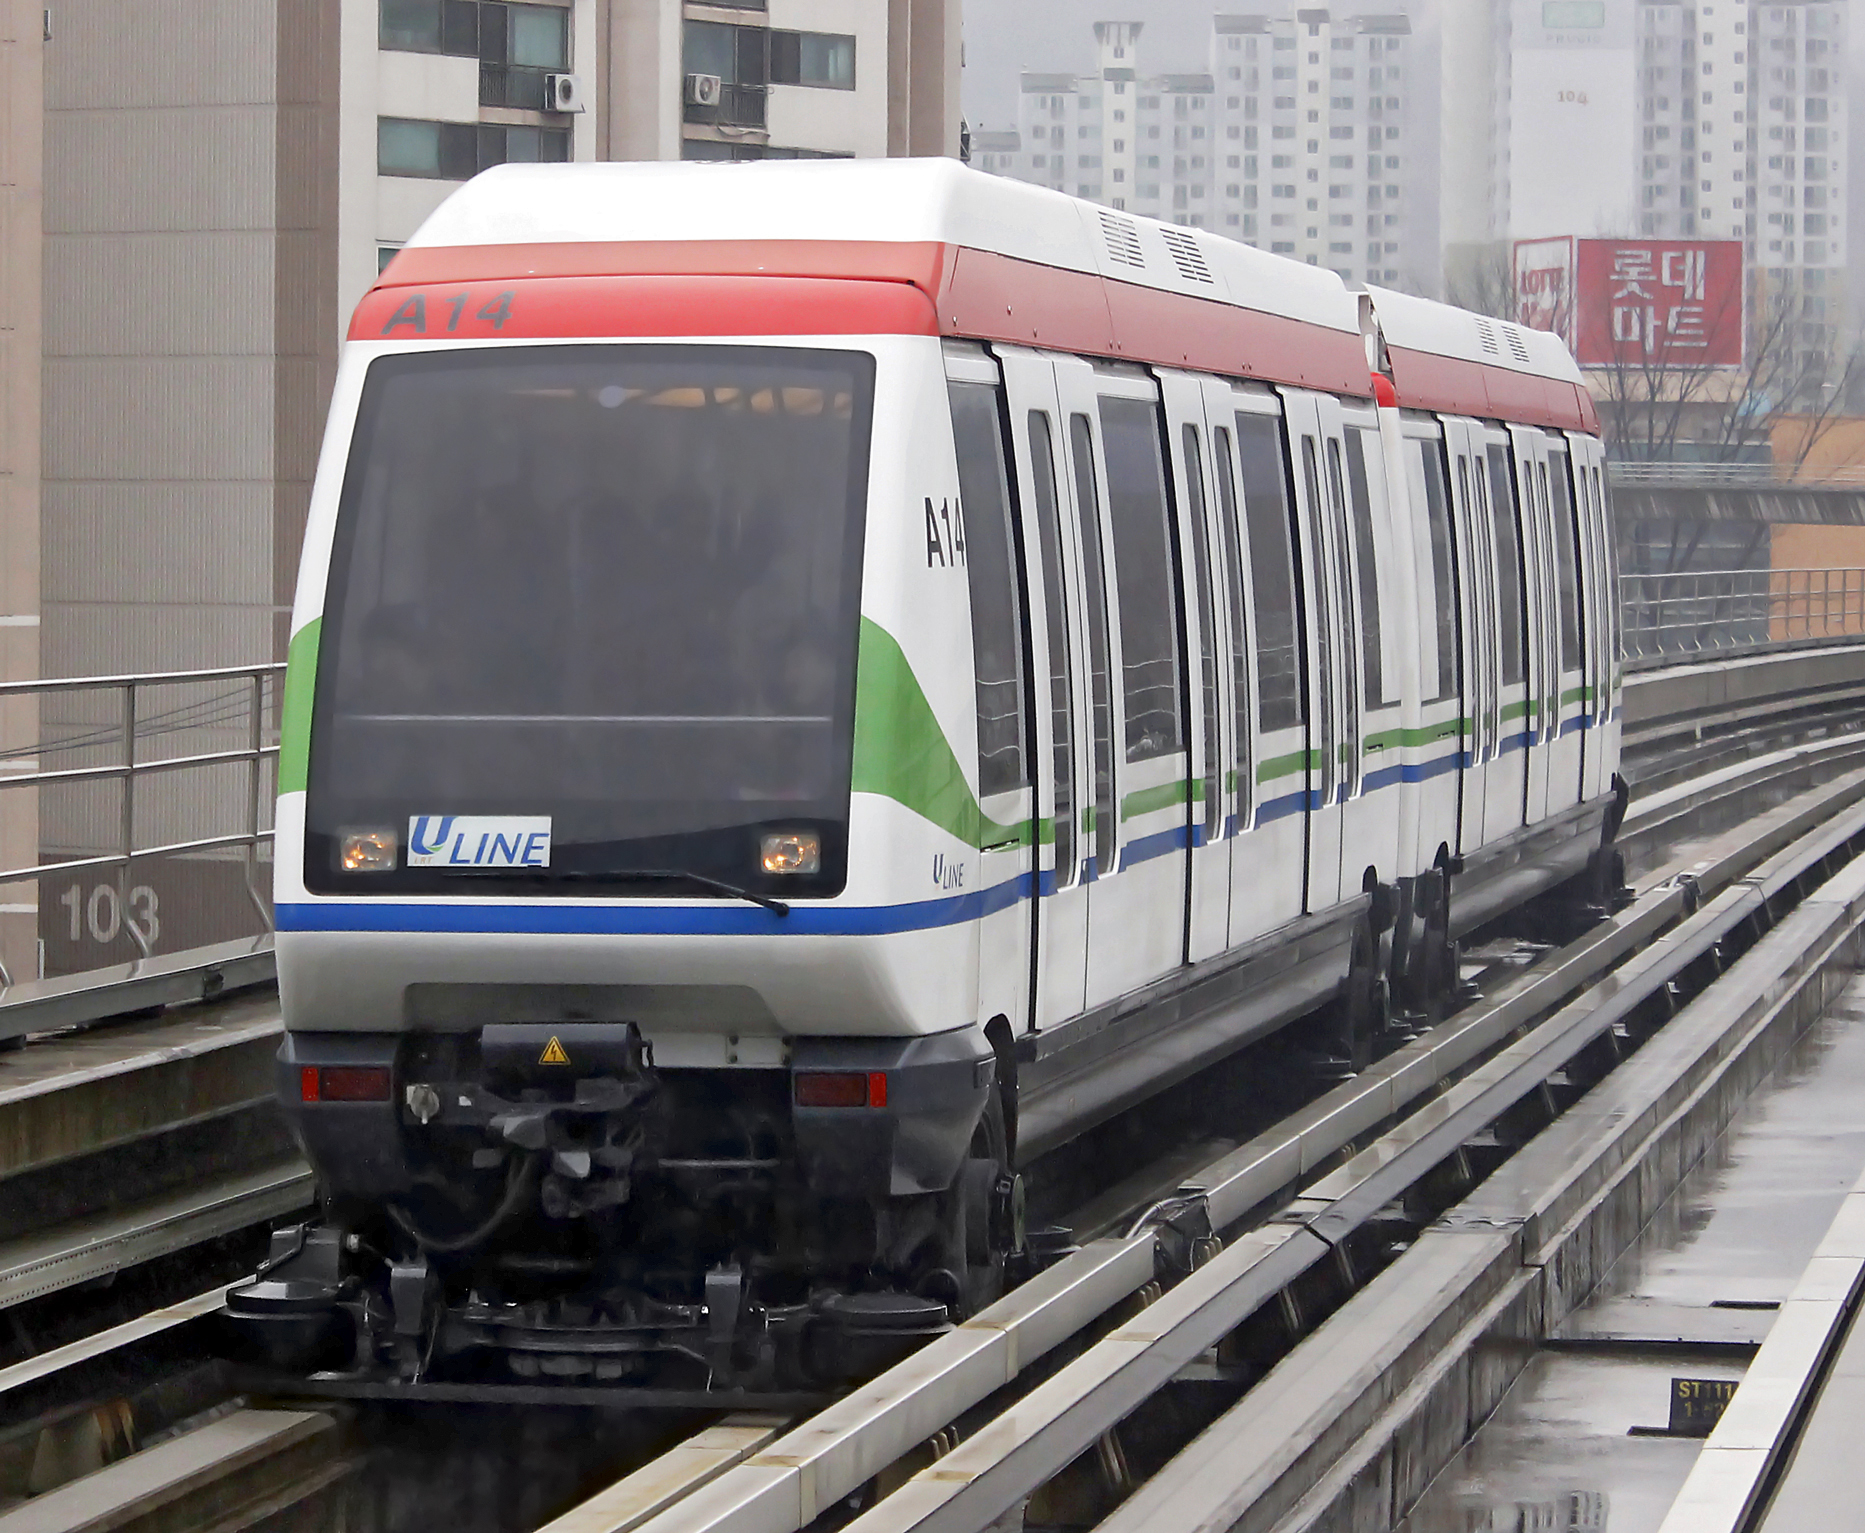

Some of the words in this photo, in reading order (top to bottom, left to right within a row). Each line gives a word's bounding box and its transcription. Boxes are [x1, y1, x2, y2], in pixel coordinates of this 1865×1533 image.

[1558, 91, 1589, 106] 104
[1609, 250, 1705, 300] 롯데
[380, 290, 516, 335] A14
[1613, 306, 1708, 355] 마트
[925, 497, 964, 567] A14
[61, 884, 159, 945] 103
